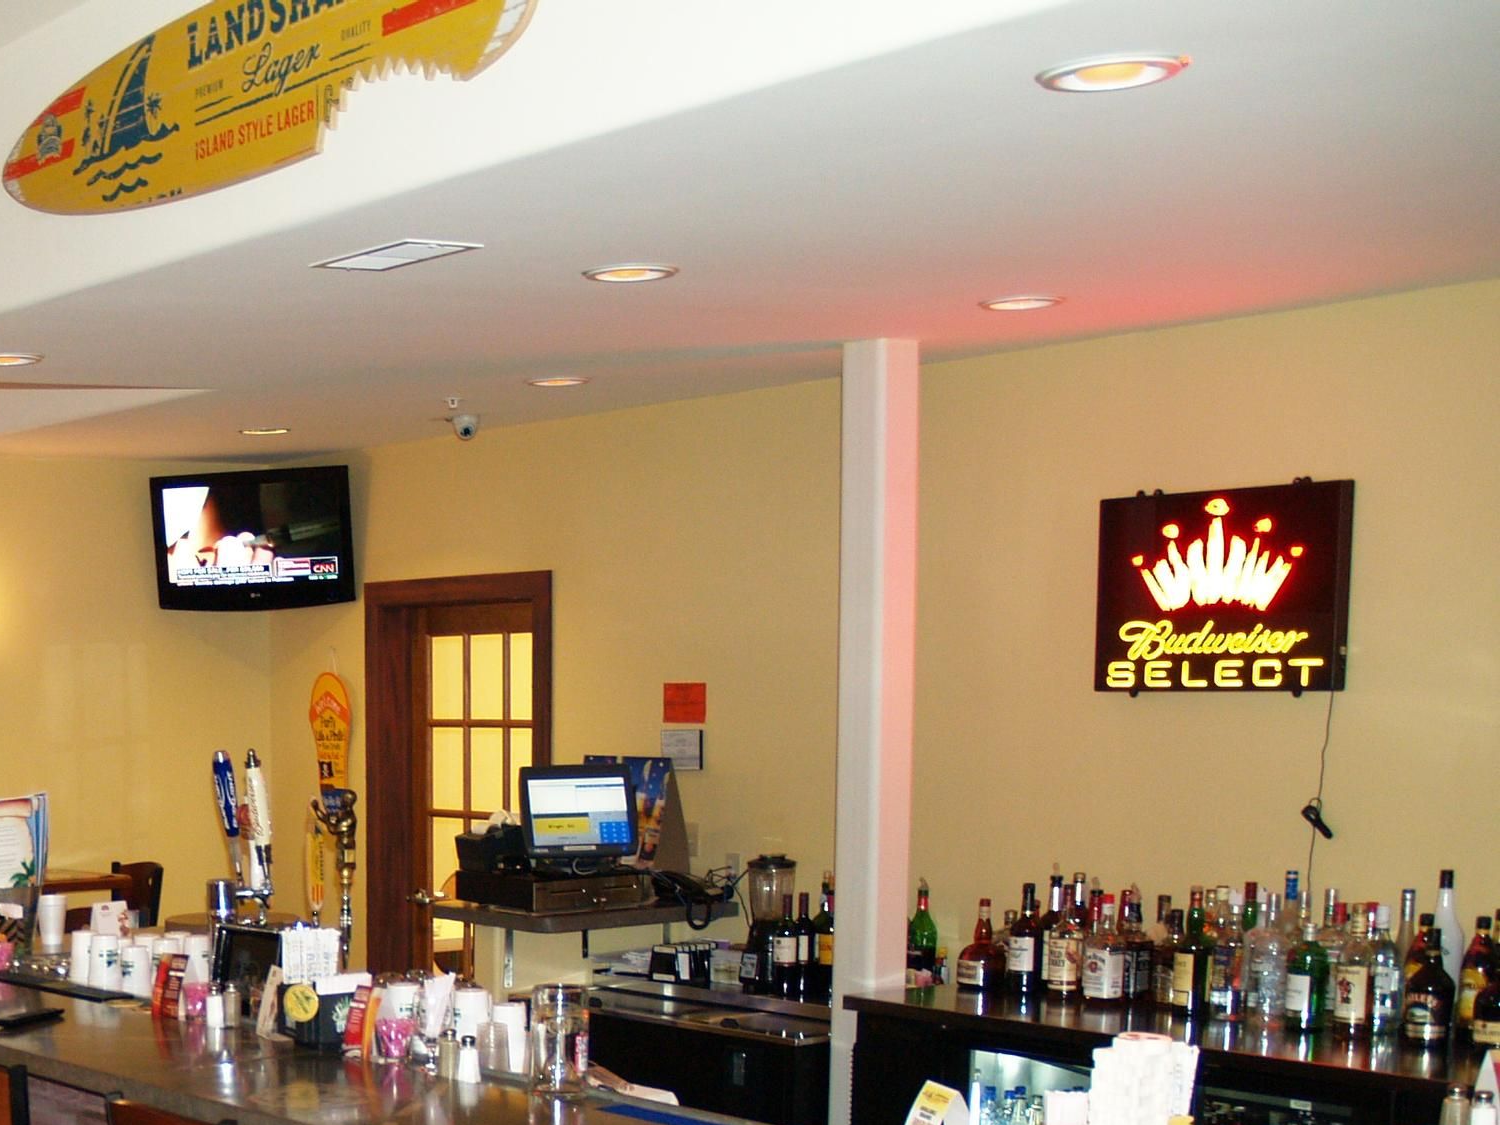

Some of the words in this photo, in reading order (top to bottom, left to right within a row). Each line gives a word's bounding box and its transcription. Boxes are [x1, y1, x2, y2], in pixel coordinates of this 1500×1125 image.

[241, 42, 320, 97] Lager
[341, 20, 371, 41] QUALITY
[195, 130, 235, 160] ISLAND
[238, 114, 273, 147] STYLE
[277, 99, 315, 132] LAGER
[313, 563, 335, 573] CNN
[1118, 618, 1309, 661] Budweiser
[1105, 658, 1325, 688] SELECT
